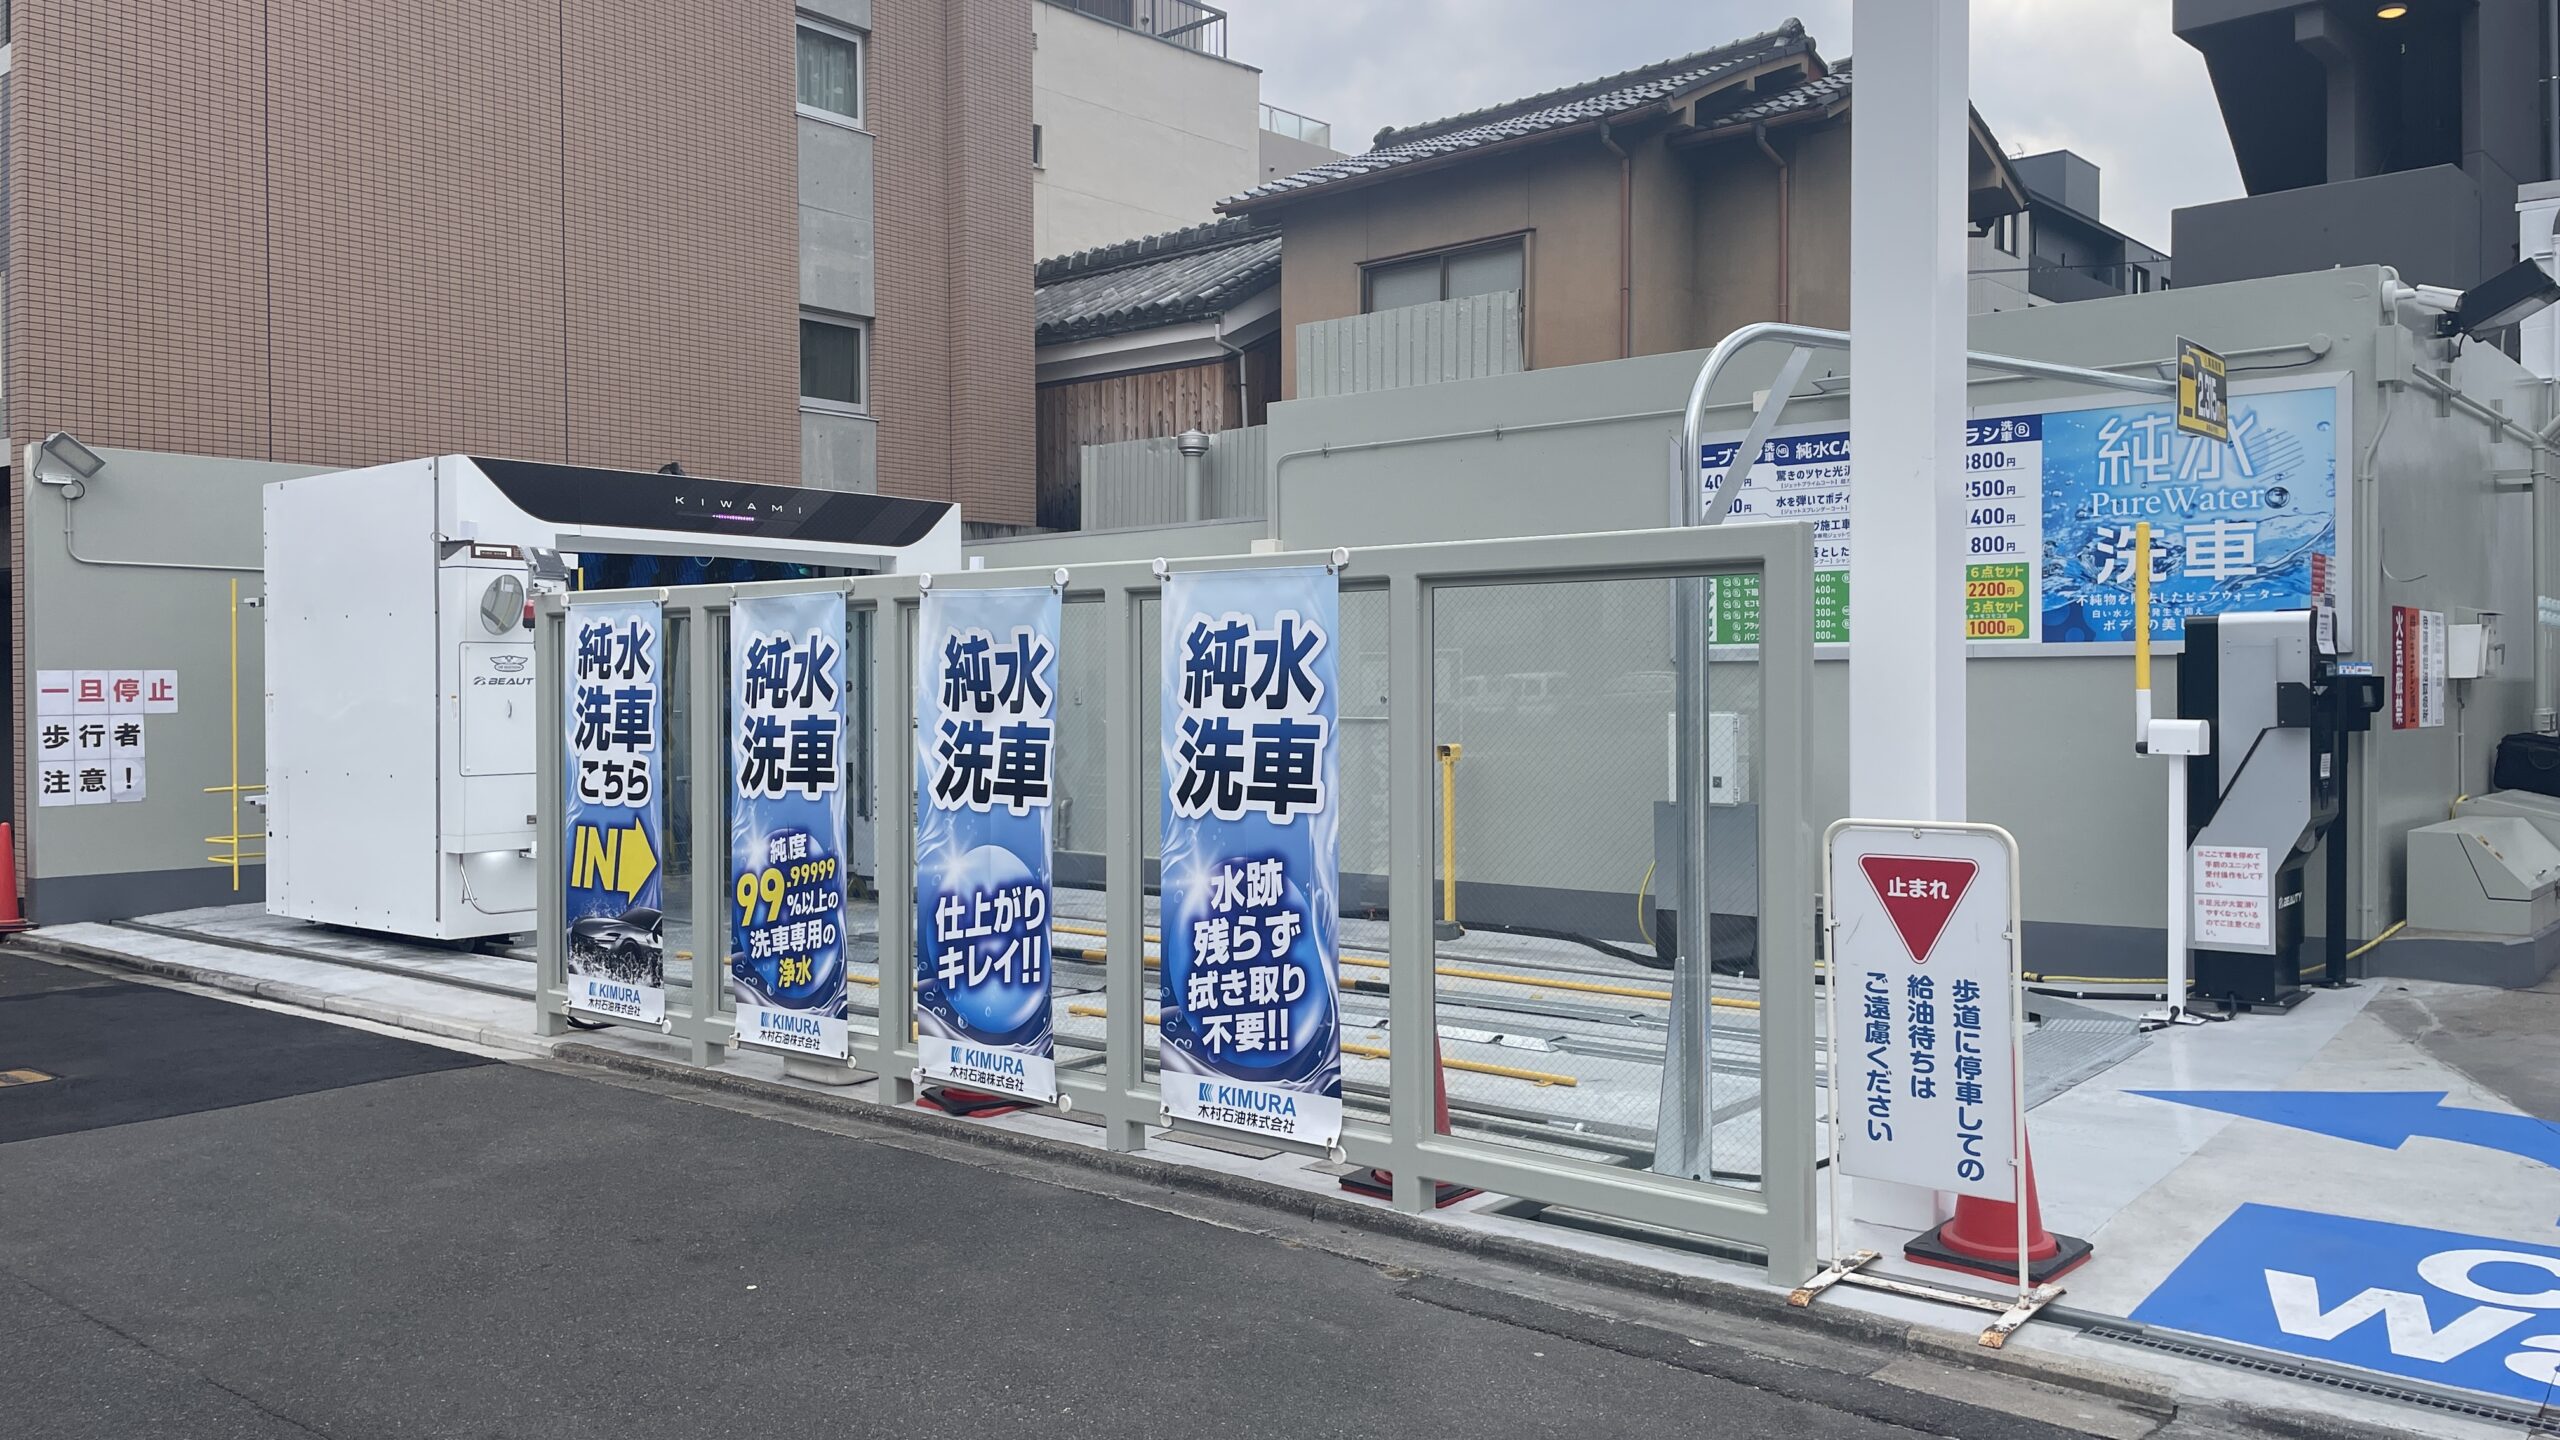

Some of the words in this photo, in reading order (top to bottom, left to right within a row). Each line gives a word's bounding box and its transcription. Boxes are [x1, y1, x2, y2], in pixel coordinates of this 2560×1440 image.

[2098, 414, 2254, 486] 純水
[675, 496, 802, 515] KIWAMI
[2091, 486, 2265, 517] PureWater
[1970, 536, 2016, 554] 800円
[2097, 520, 2257, 584] 洗車
[1968, 582, 2015, 598] 2200円
[1970, 565, 2024, 579] 6点セット
[1969, 621, 2015, 636] 1000円
[577, 622, 651, 680] 純水
[745, 635, 835, 708] 純水
[1184, 619, 1319, 710] 純水
[41, 678, 174, 703] 一旦停止
[943, 633, 1048, 714] 純水
[42, 722, 141, 750] 歩行者
[575, 685, 653, 753] 洗車
[741, 714, 837, 793] 洗車
[935, 718, 1050, 808] 洗車
[1176, 715, 1321, 815] 洗車
[43, 767, 133, 795] 注意!
[580, 759, 649, 801] こちら
[571, 825, 618, 891] IN
[770, 833, 807, 864] 純度
[786, 887, 839, 917] %以上の
[1210, 857, 1284, 914] 水跡
[1887, 877, 1950, 900] 止まれ
[935, 885, 1046, 943] 仕上がり
[750, 918, 836, 960] 洗車専用の
[1194, 910, 1302, 968] 残らず
[778, 955, 812, 988] 浄水
[937, 935, 1042, 990] キレイ!!
[588, 998, 641, 1017] 木村石油株式会社
[599, 982, 641, 1004] KIMURA
[1188, 963, 1306, 1012] 拭き取り
[759, 1030, 820, 1050] 木村石油株式会社
[772, 1013, 821, 1036] KIMURA
[1202, 1007, 1289, 1055] 不要!!
[1907, 974, 1936, 1099] 給油待ちは
[965, 1048, 1025, 1077] KIMURA
[1864, 972, 1893, 1142] ご遠慮ください
[949, 1065, 1024, 1092] 木村石油株式会社
[1952, 979, 1985, 1182] 歩道に停車しての
[1198, 1104, 1296, 1135] 木村石油株式会社
[1218, 1085, 1297, 1117] KIMURA
